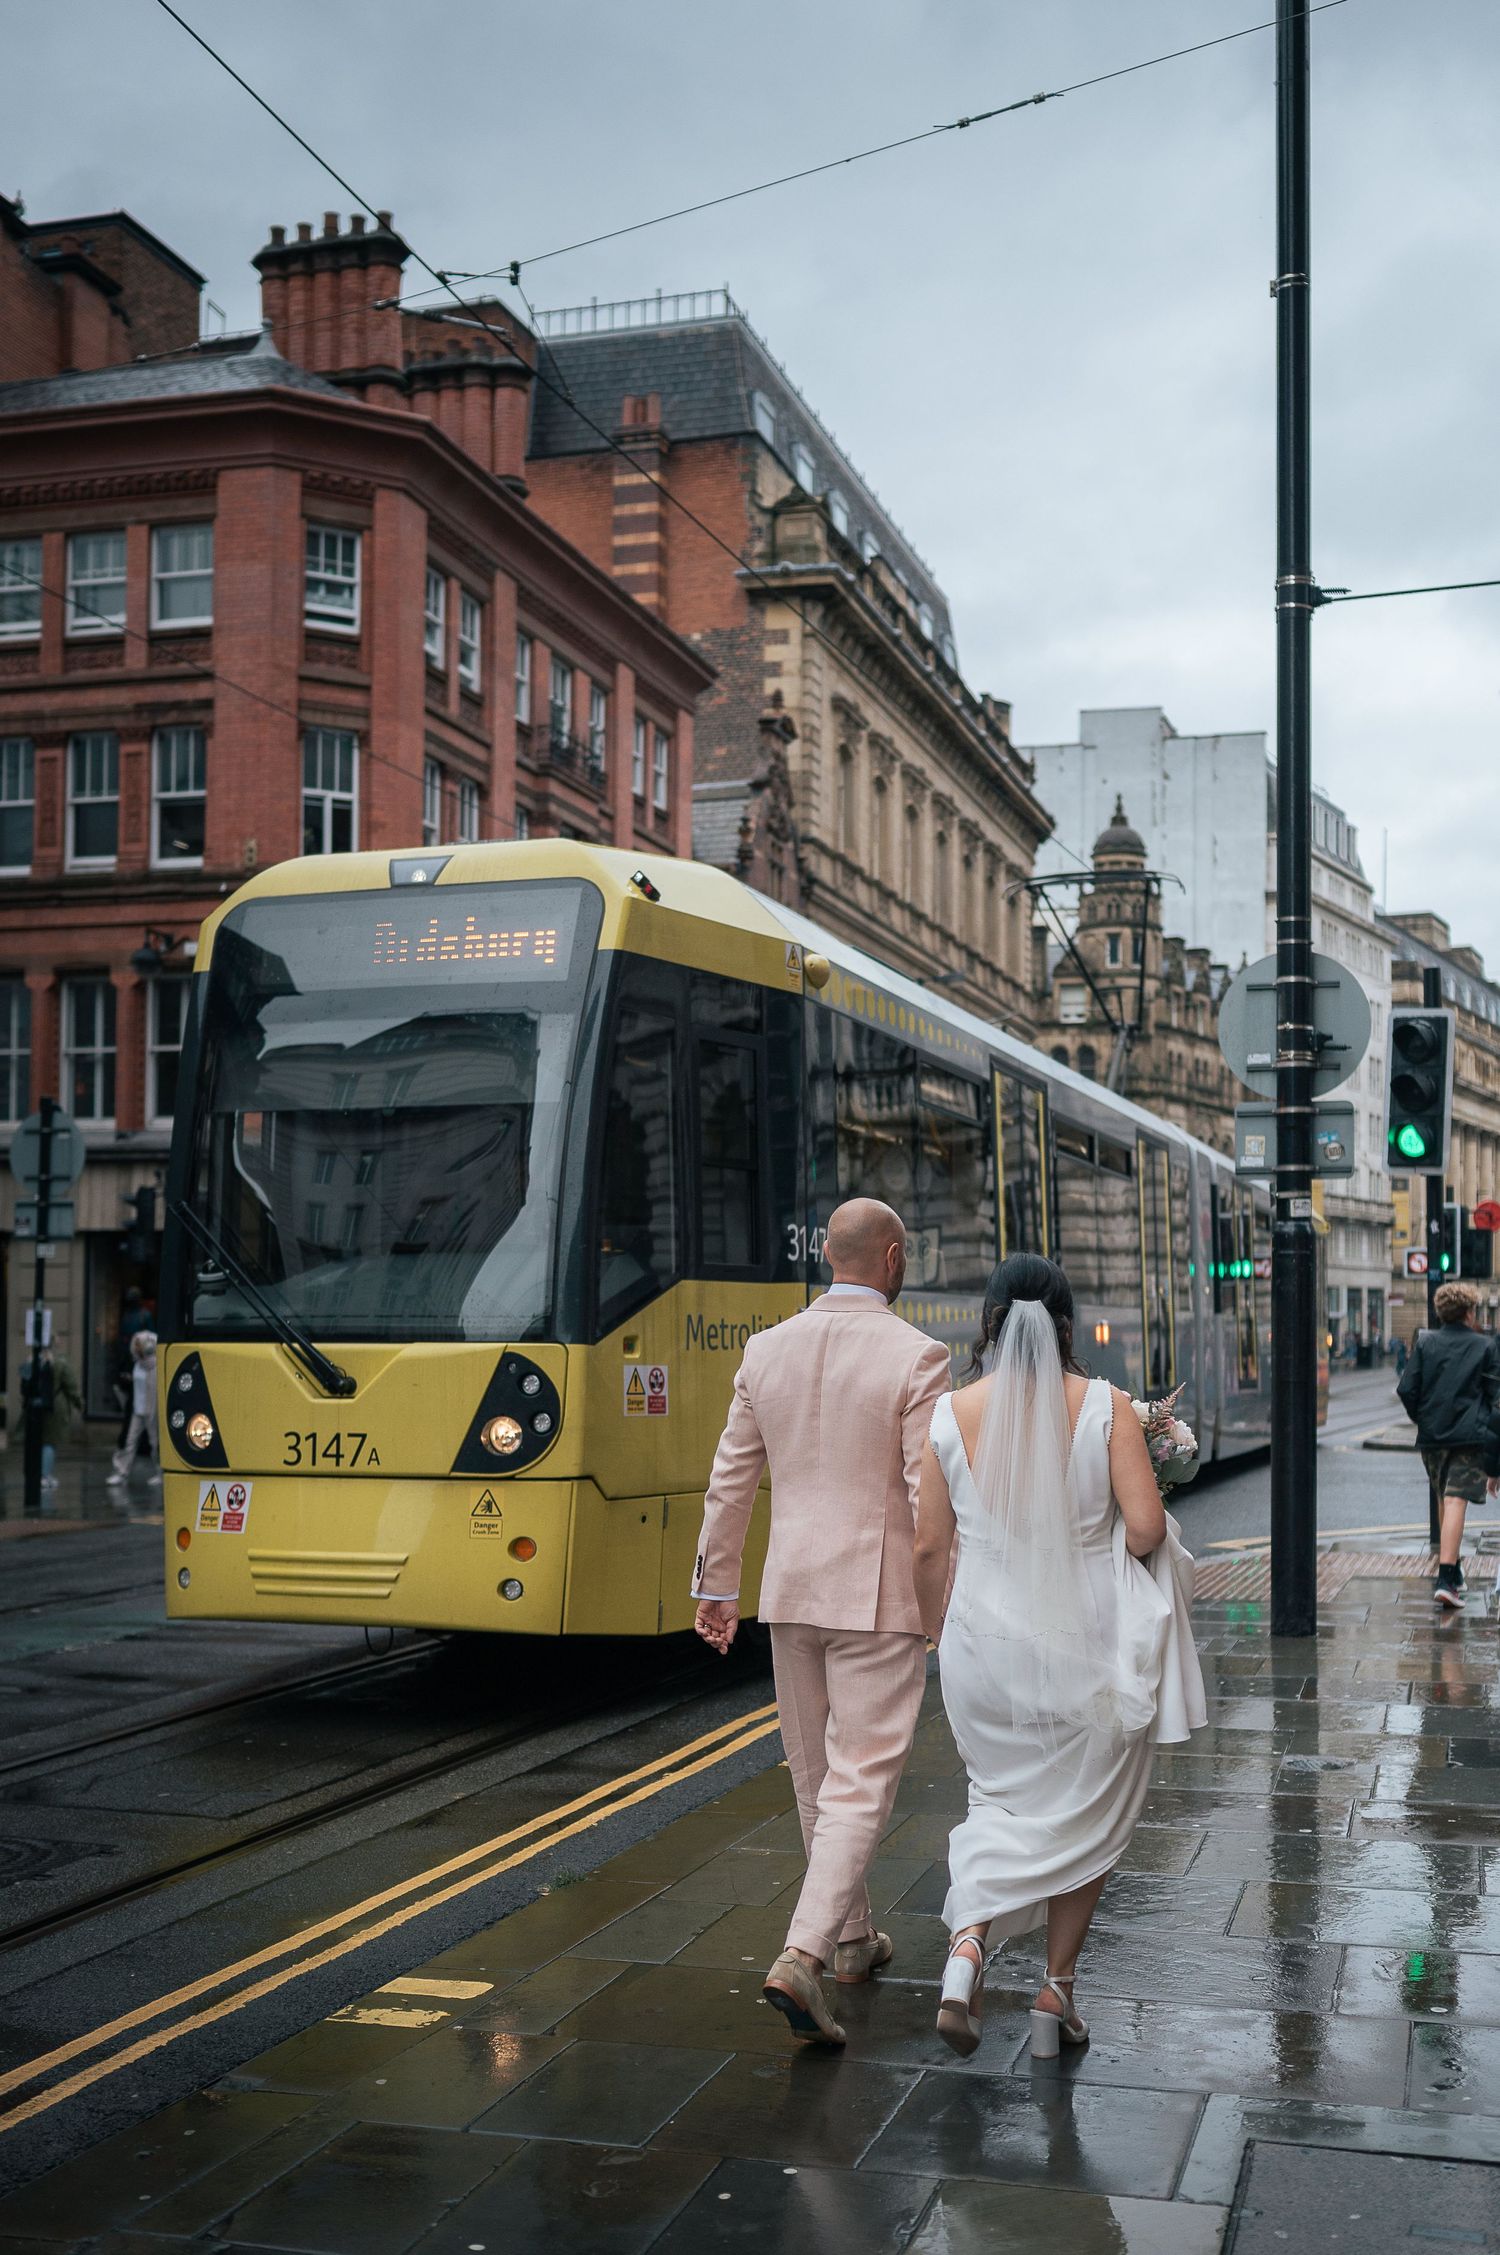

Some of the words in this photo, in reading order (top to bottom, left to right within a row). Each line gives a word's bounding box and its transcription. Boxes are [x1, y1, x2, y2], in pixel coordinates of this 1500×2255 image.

[686, 1314, 782, 1351] Metrol
[283, 1431, 381, 1467] 3147A
[474, 1521, 499, 1531] Danger
